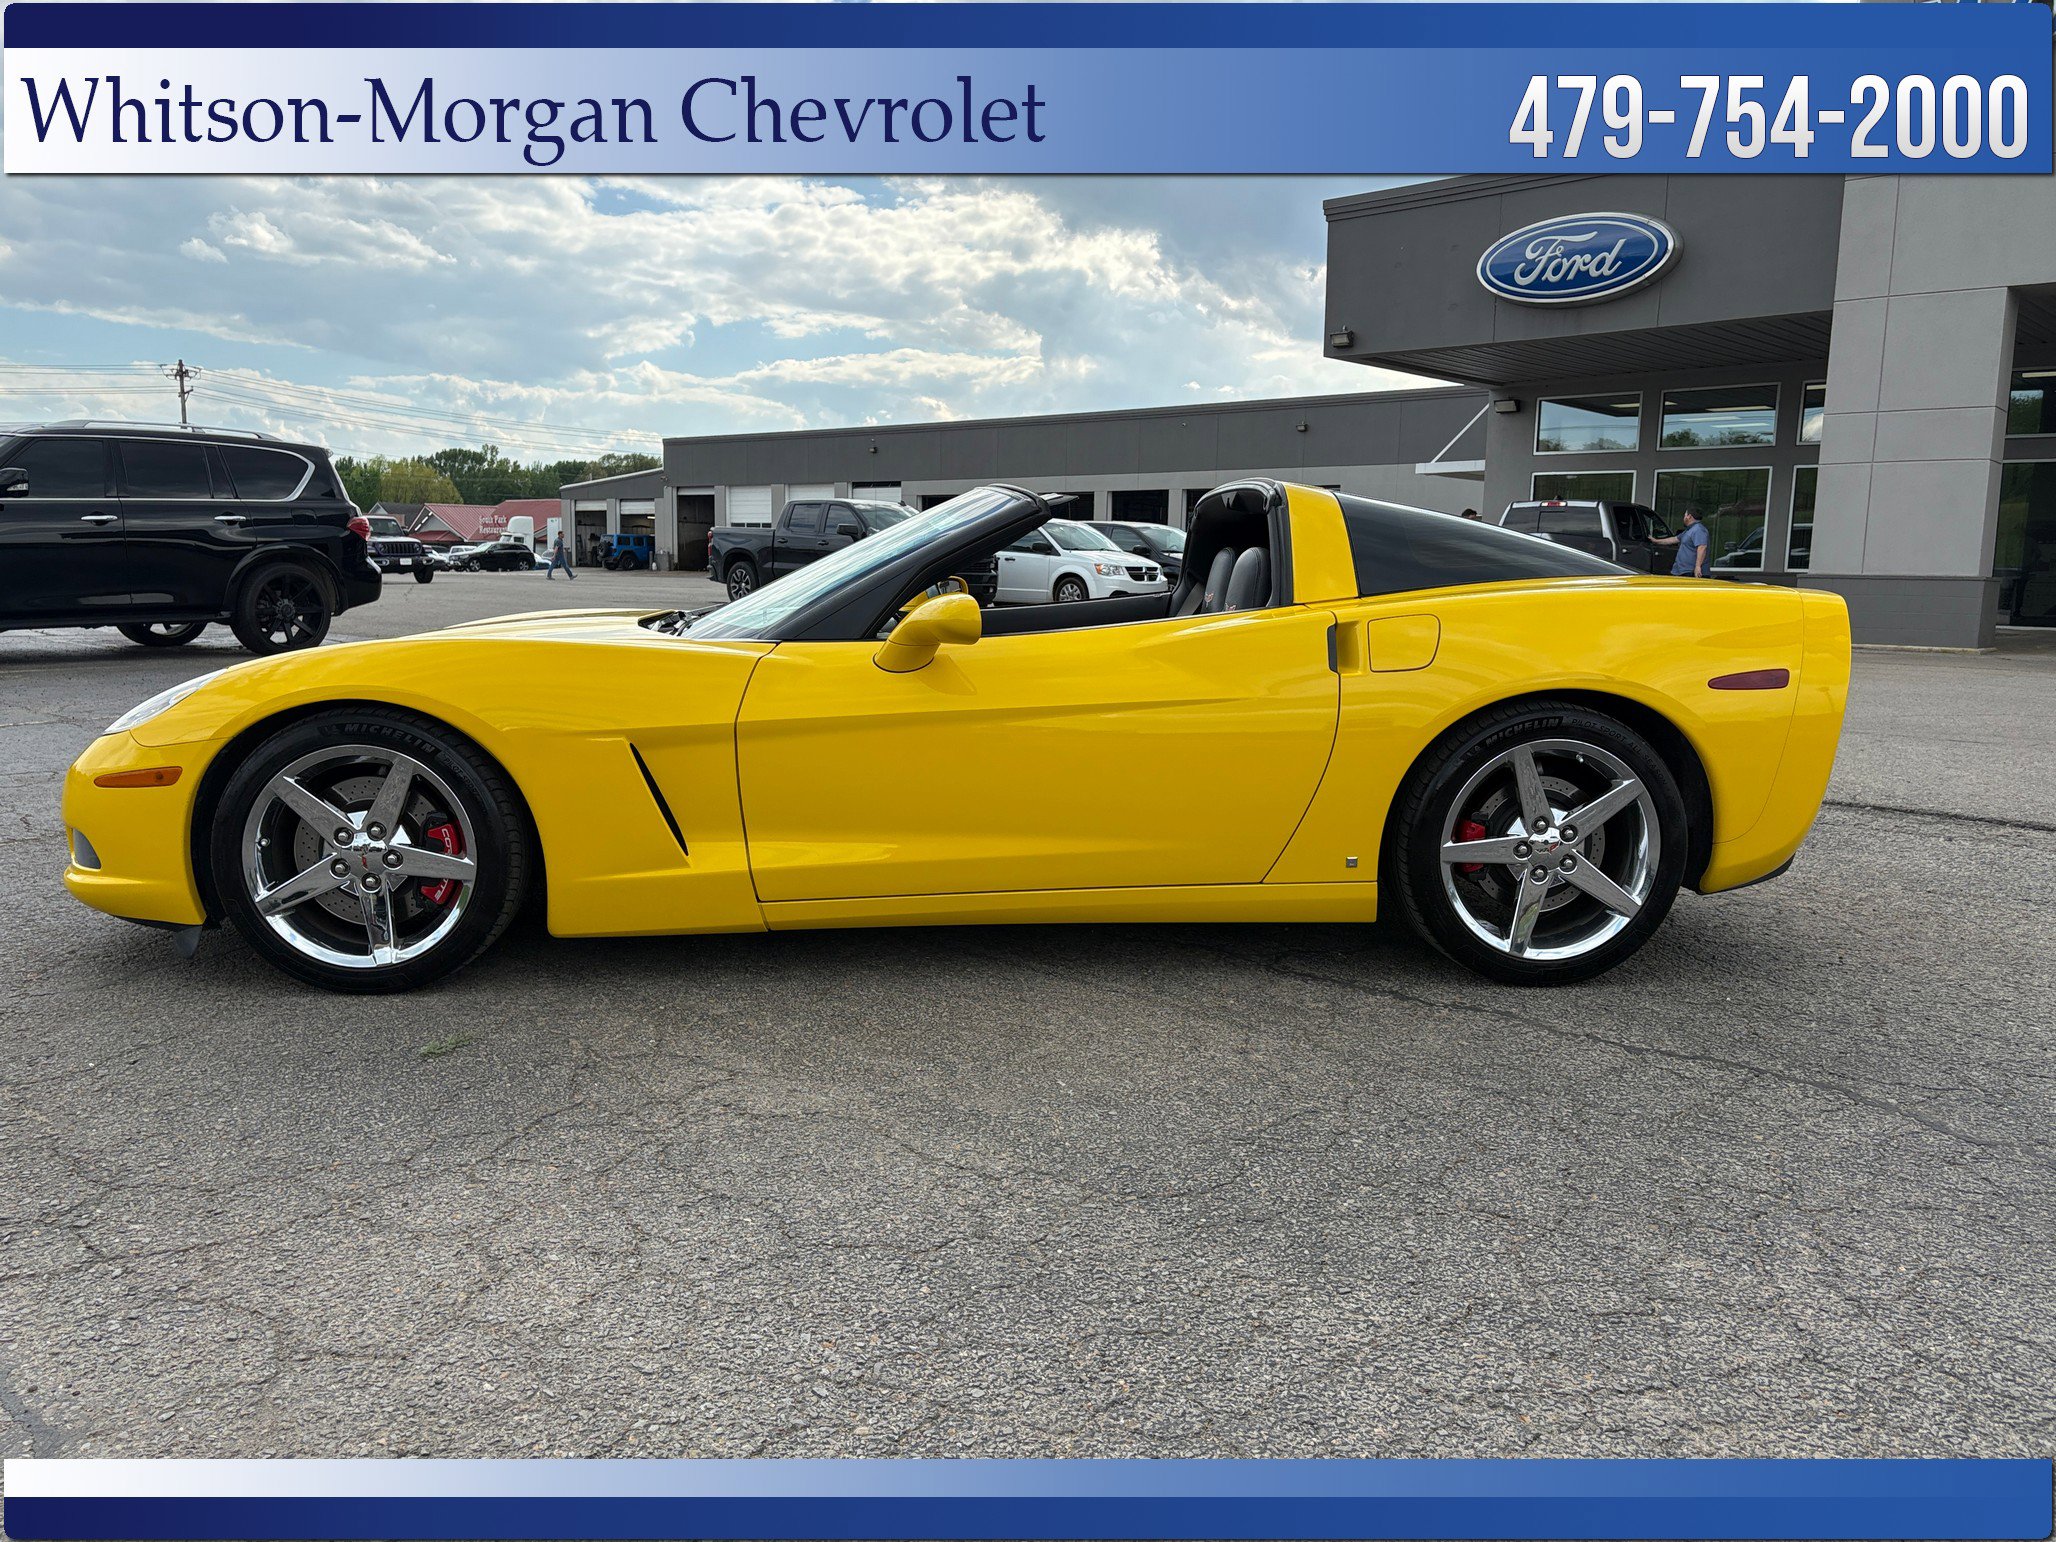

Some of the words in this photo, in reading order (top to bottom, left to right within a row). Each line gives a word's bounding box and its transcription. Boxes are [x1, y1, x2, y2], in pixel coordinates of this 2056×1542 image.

[1514, 231, 1627, 286] Ford
[494, 515, 507, 524] Park
[344, 722, 437, 754] MICHELIN
[1486, 717, 1560, 747] MICHELIN
[1571, 717, 1597, 729] PILOT
[1599, 725, 1626, 742] SPORT
[1643, 754, 1668, 786] SEASON
